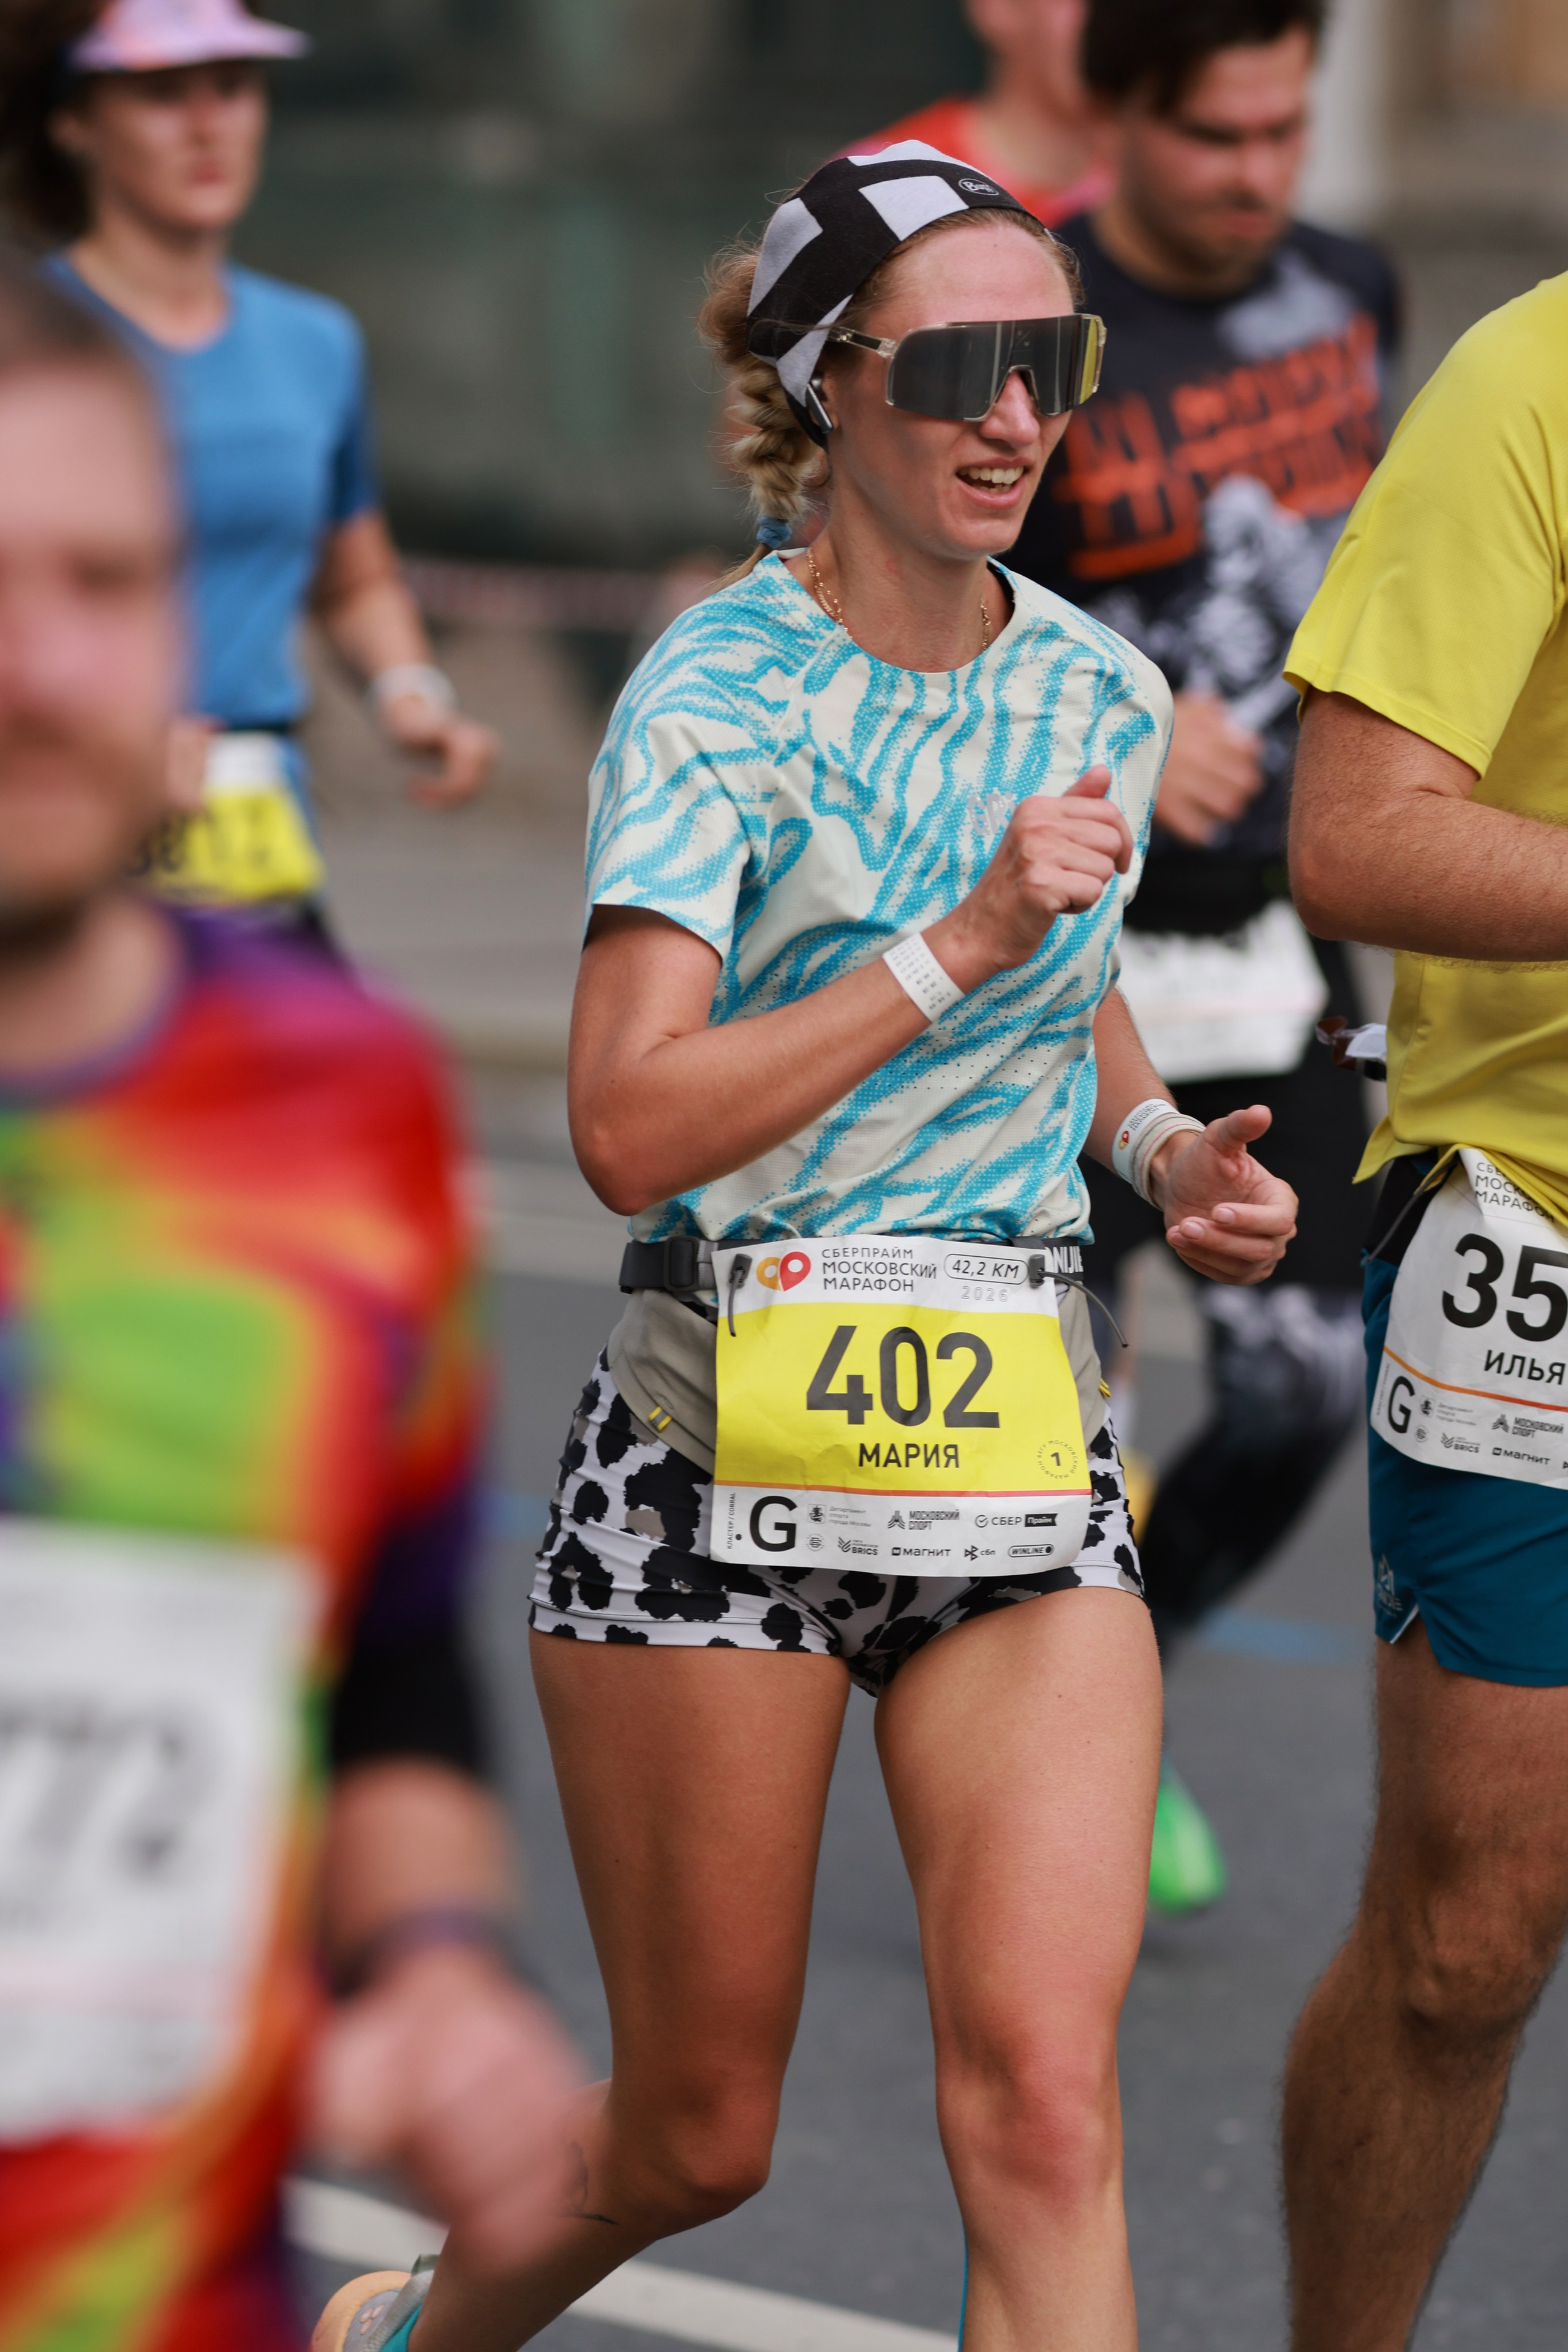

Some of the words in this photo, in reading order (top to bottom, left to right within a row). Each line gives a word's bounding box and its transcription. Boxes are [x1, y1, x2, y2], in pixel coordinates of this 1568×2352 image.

[822, 1246, 913, 1259] СБЕРПРАЙМ
[823, 1262, 937, 1279] МОСКОВСКИЙ
[952, 1259, 986, 1277] 42,2
[823, 1277, 914, 1292] МАРАФОН
[961, 1286, 1008, 1302] 2026
[1483, 1349, 1566, 1385] ИЛЬЯ
[806, 1325, 1000, 1428] 402
[1388, 1376, 1415, 1434] G
[859, 1442, 959, 1469] МАРИЯ
[1454, 1443, 1479, 1453] BRICS
[1050, 1452, 1061, 1466] 1
[910, 1509, 959, 1520] МОСКОВСКИЙ
[992, 1517, 1022, 1525] СБЕР
[1027, 1516, 1052, 1525] Прайм
[750, 1495, 797, 1552] G
[908, 1521, 932, 1530] СПОРТ
[852, 1547, 878, 1555] BRICS
